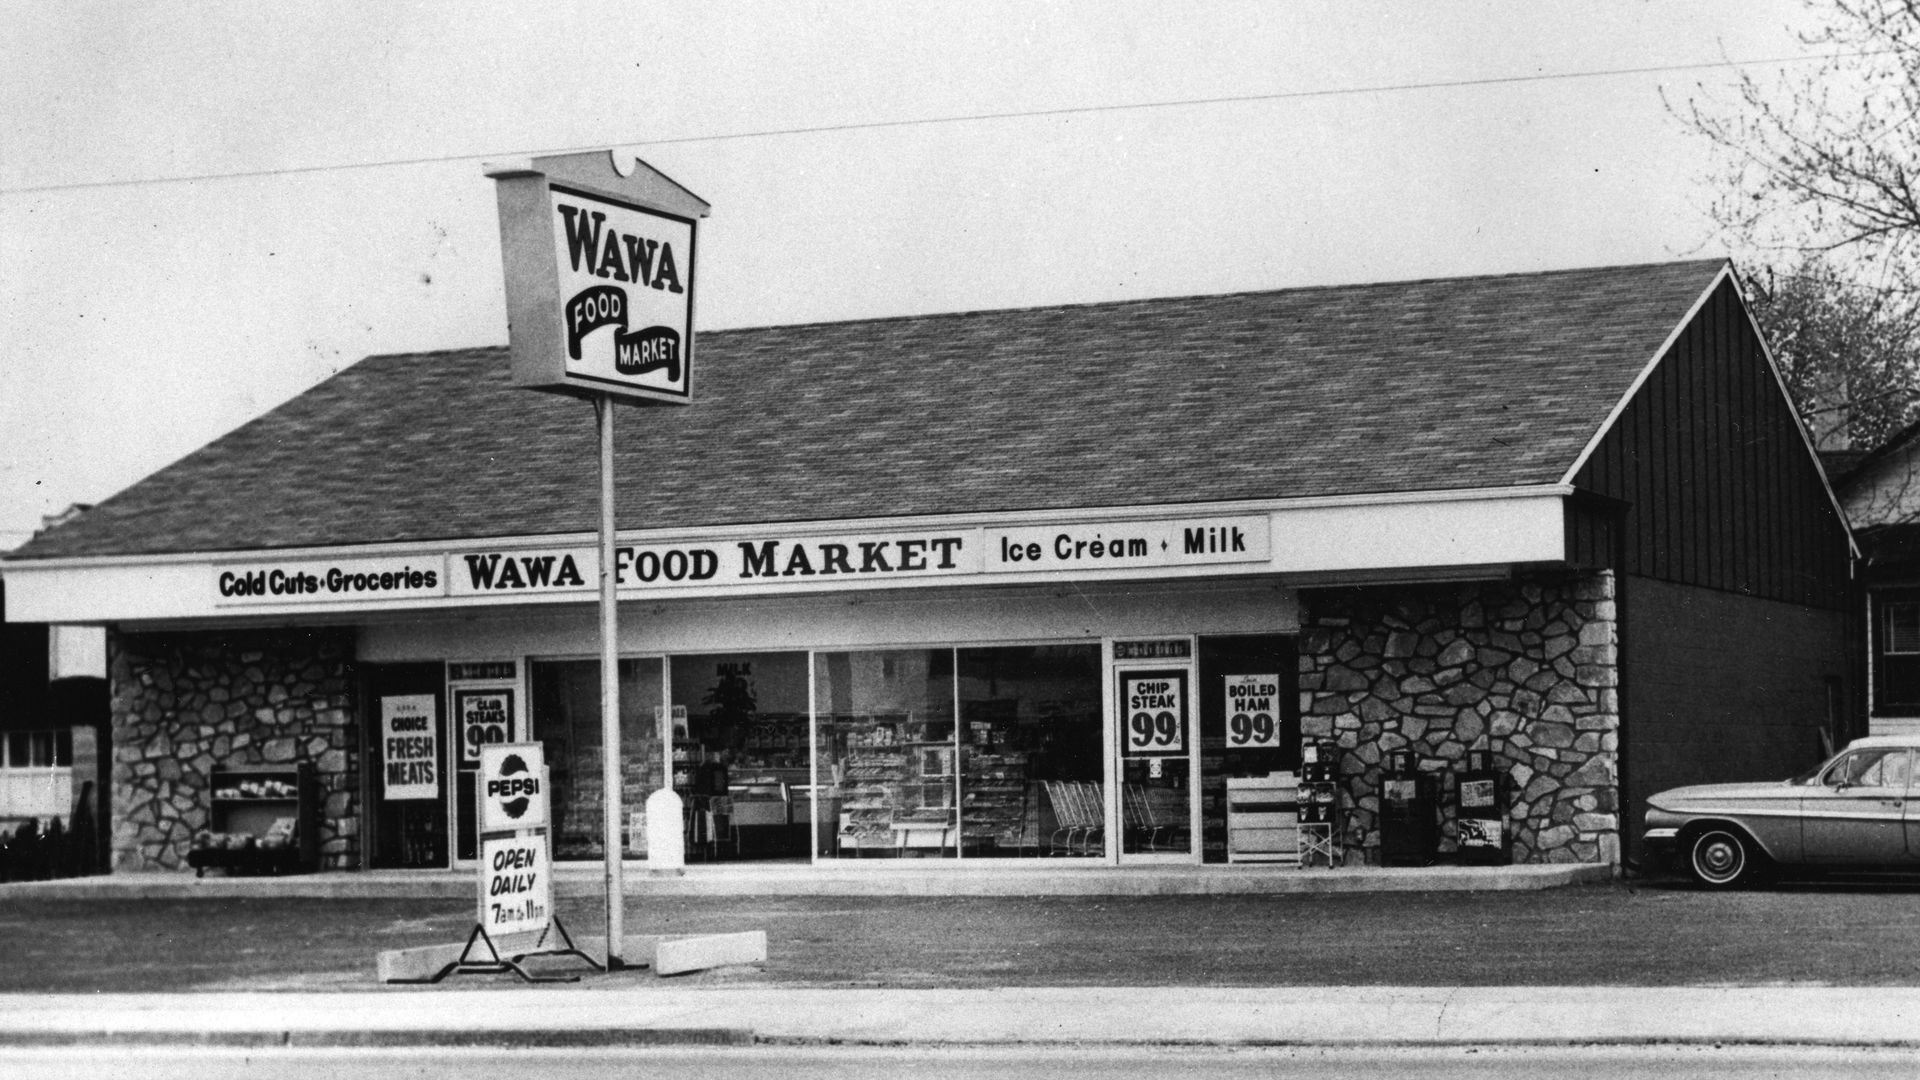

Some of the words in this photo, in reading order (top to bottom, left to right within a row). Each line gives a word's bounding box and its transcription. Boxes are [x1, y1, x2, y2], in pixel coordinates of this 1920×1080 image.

[557, 203, 684, 294] WAWA
[574, 292, 621, 334] FOOD
[619, 336, 676, 366] MARKET
[1001, 536, 1042, 562] Ice
[1054, 533, 1148, 561] Cream
[1184, 526, 1246, 555] Milk
[464, 553, 585, 590] WAWA
[615, 547, 719, 584] FOOD
[737, 537, 963, 579] MARKET
[219, 571, 266, 597] Cold
[1136, 681, 1171, 695] CHIP
[1229, 683, 1277, 698] BOILED
[477, 699, 502, 711] CLUB
[1131, 694, 1176, 710] STEAK
[1234, 697, 1270, 713] HAM
[390, 715, 428, 732] CHOICE
[466, 710, 506, 725] STEAKS
[1131, 711, 1177, 747] 99
[1230, 712, 1275, 745] 99
[386, 736, 434, 760] FRESH
[386, 760, 434, 786] MEATS
[487, 777, 540, 798] PEPSI
[493, 847, 536, 872] OPEN
[490, 872, 537, 897] DAILY
